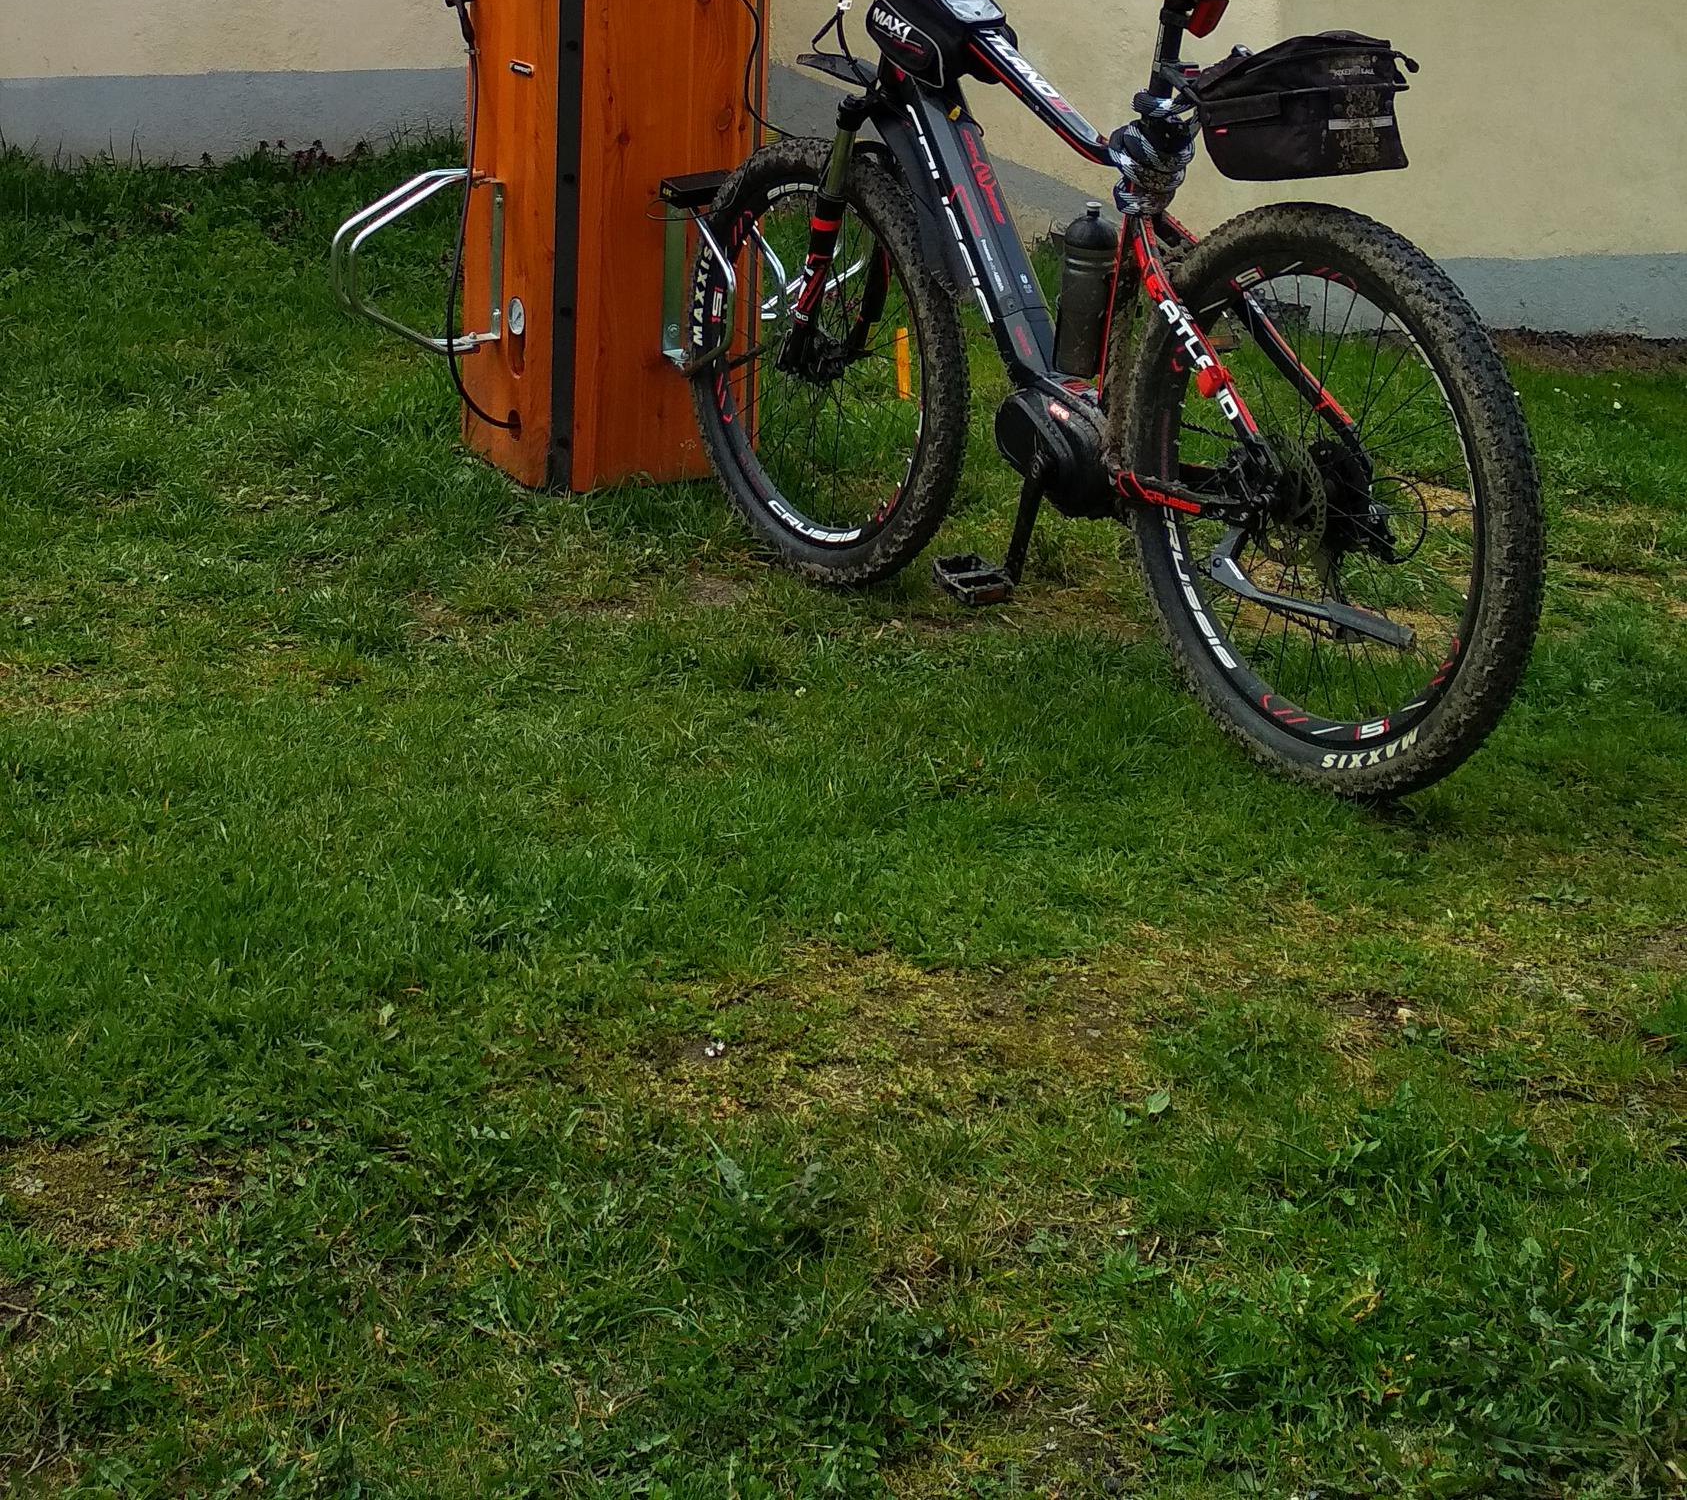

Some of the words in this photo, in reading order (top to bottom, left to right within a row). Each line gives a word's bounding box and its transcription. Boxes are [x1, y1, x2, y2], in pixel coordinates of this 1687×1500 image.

[872, 7, 912, 43] MAX1
[979, 29, 1060, 98] TLAND
[692, 245, 714, 347] MAXXIS
[768, 499, 862, 543] CRUSSIS
[1320, 725, 1421, 770] MAXXIS
